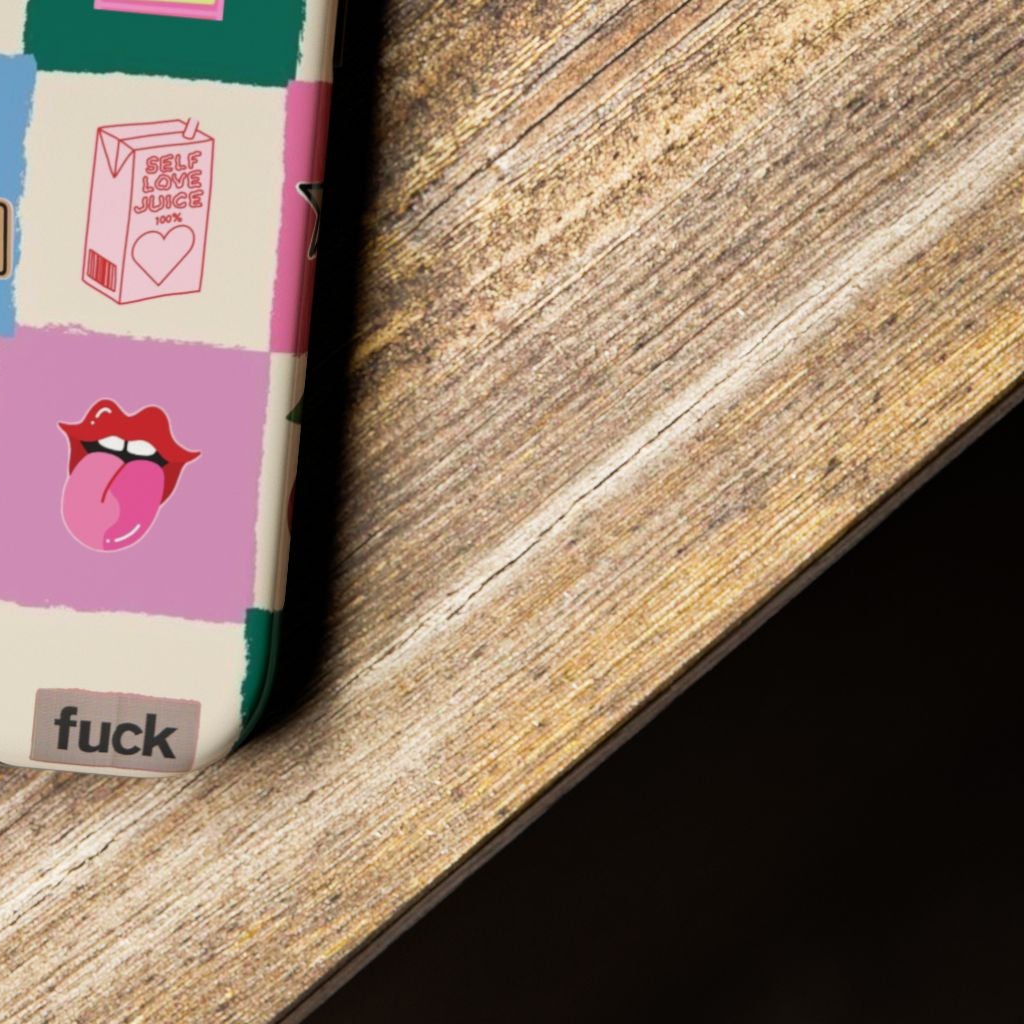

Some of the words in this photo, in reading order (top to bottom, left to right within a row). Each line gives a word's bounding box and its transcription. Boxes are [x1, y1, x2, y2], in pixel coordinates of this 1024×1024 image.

[146, 150, 202, 174] SELF
[142, 170, 202, 193] LOVE
[134, 189, 204, 214] JUICE
[155, 213, 182, 225] 100%
[54, 706, 178, 759] fuck
